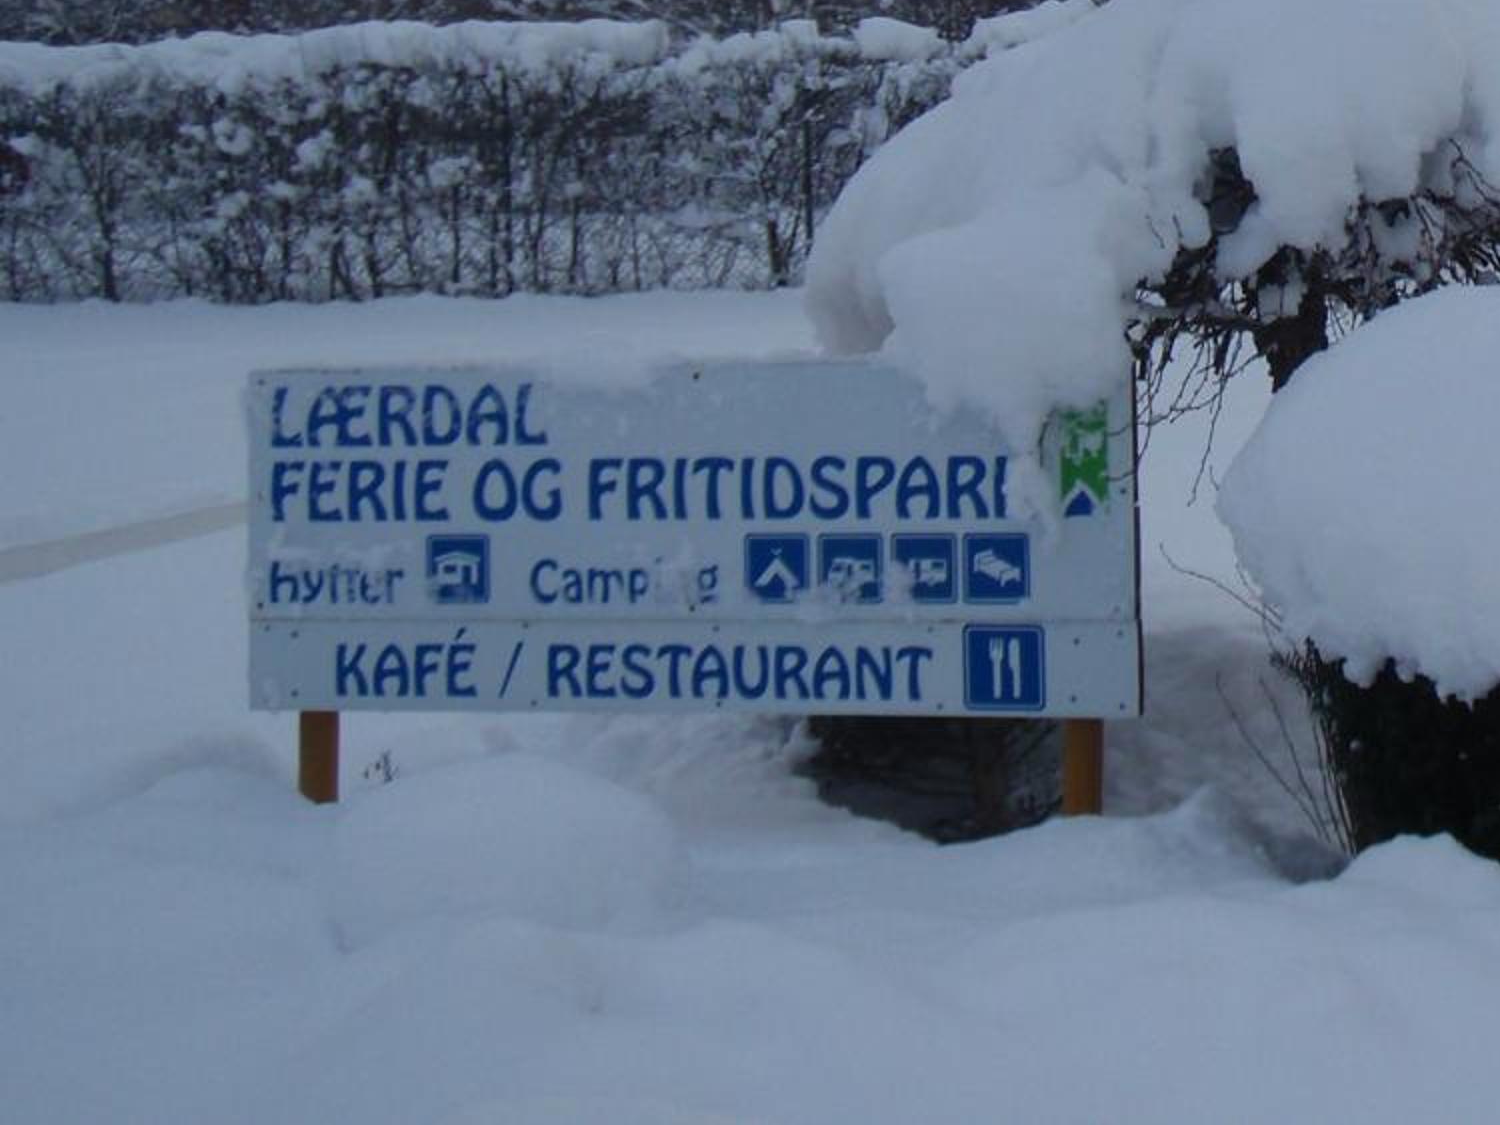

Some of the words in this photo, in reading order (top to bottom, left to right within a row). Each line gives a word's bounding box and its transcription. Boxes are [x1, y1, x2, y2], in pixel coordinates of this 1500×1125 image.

[270, 383, 549, 448] LÆRDAL
[270, 459, 451, 523] FERIE
[472, 457, 563, 522] OG
[335, 626, 478, 698] KAFÉ
[499, 641, 524, 699] /
[547, 643, 934, 701] RESTAURANT
